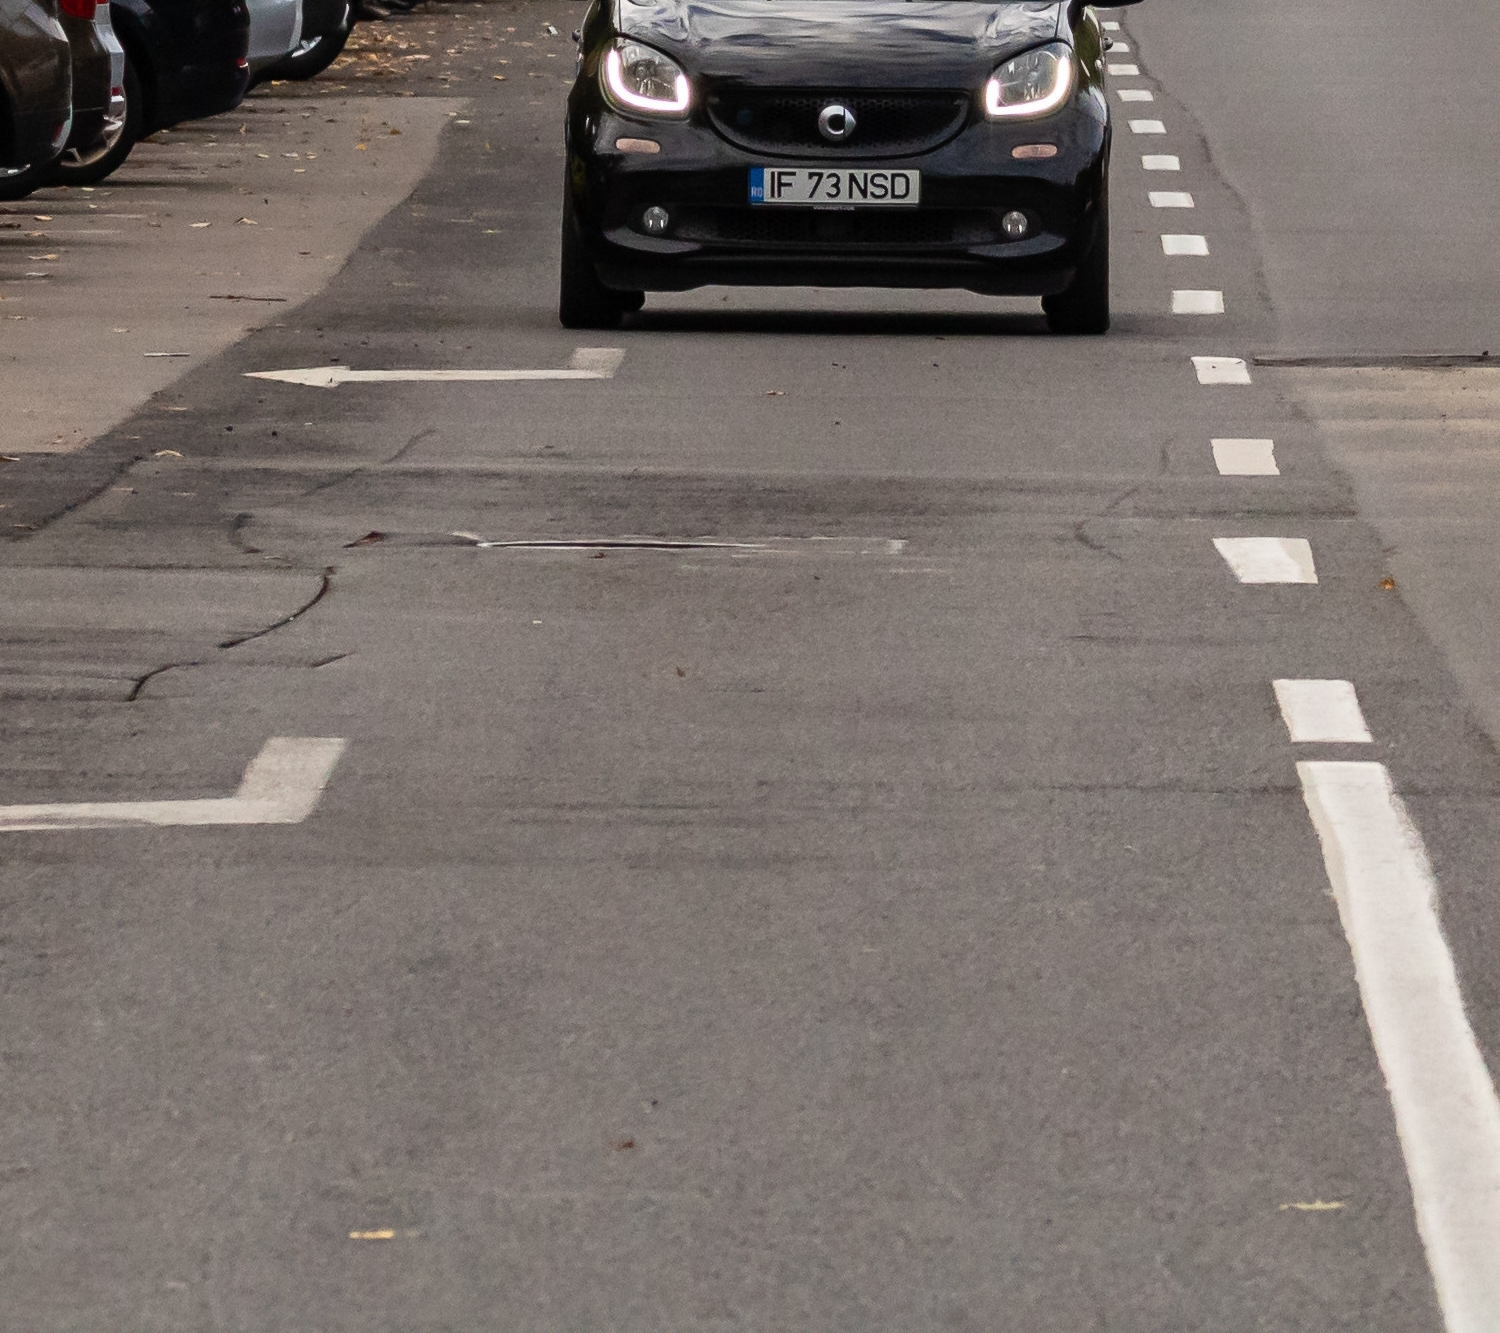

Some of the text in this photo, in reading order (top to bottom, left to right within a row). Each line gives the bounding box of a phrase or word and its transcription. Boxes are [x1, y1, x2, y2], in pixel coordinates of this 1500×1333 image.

[770, 170, 797, 199] IF
[807, 171, 841, 199] 73
[848, 172, 911, 200] NSD
